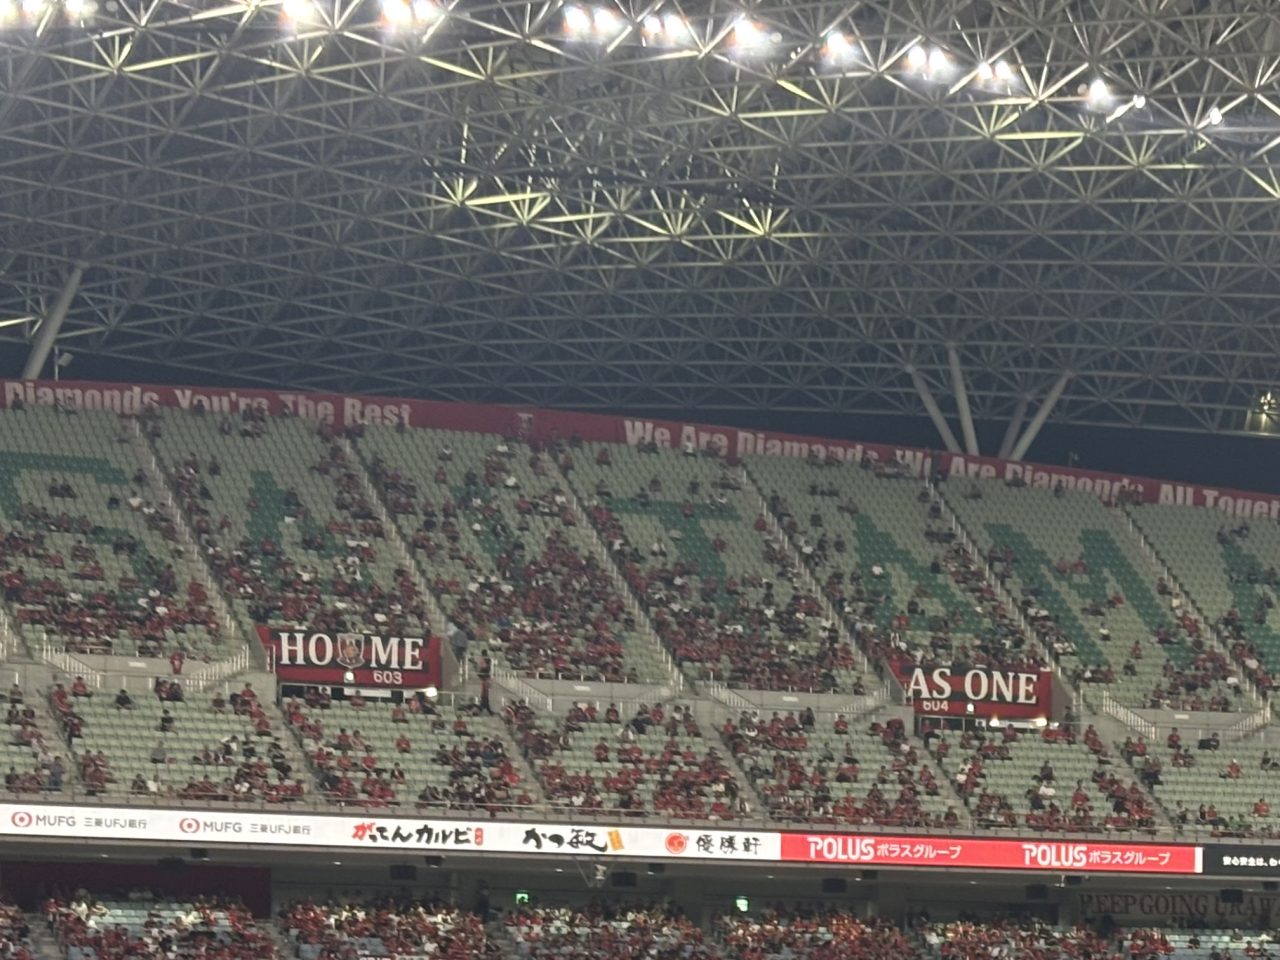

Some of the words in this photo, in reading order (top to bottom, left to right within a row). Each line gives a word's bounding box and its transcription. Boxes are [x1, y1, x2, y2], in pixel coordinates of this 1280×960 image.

[624, 420, 671, 449] We
[681, 425, 729, 457] Are
[1159, 483, 1194, 507] All
[278, 631, 424, 671] HOME
[373, 670, 403, 685] 603
[907, 667, 952, 699] AS
[964, 669, 1038, 704] ONE
[922, 700, 949, 712] 604
[35, 814, 77, 828] MUFG
[203, 820, 243, 833] MUFG
[807, 837, 875, 860] POLUS
[877, 843, 962, 859] ポラスグループ
[1022, 844, 1088, 867] POLUS
[1089, 850, 1171, 866] ポラスグループ
